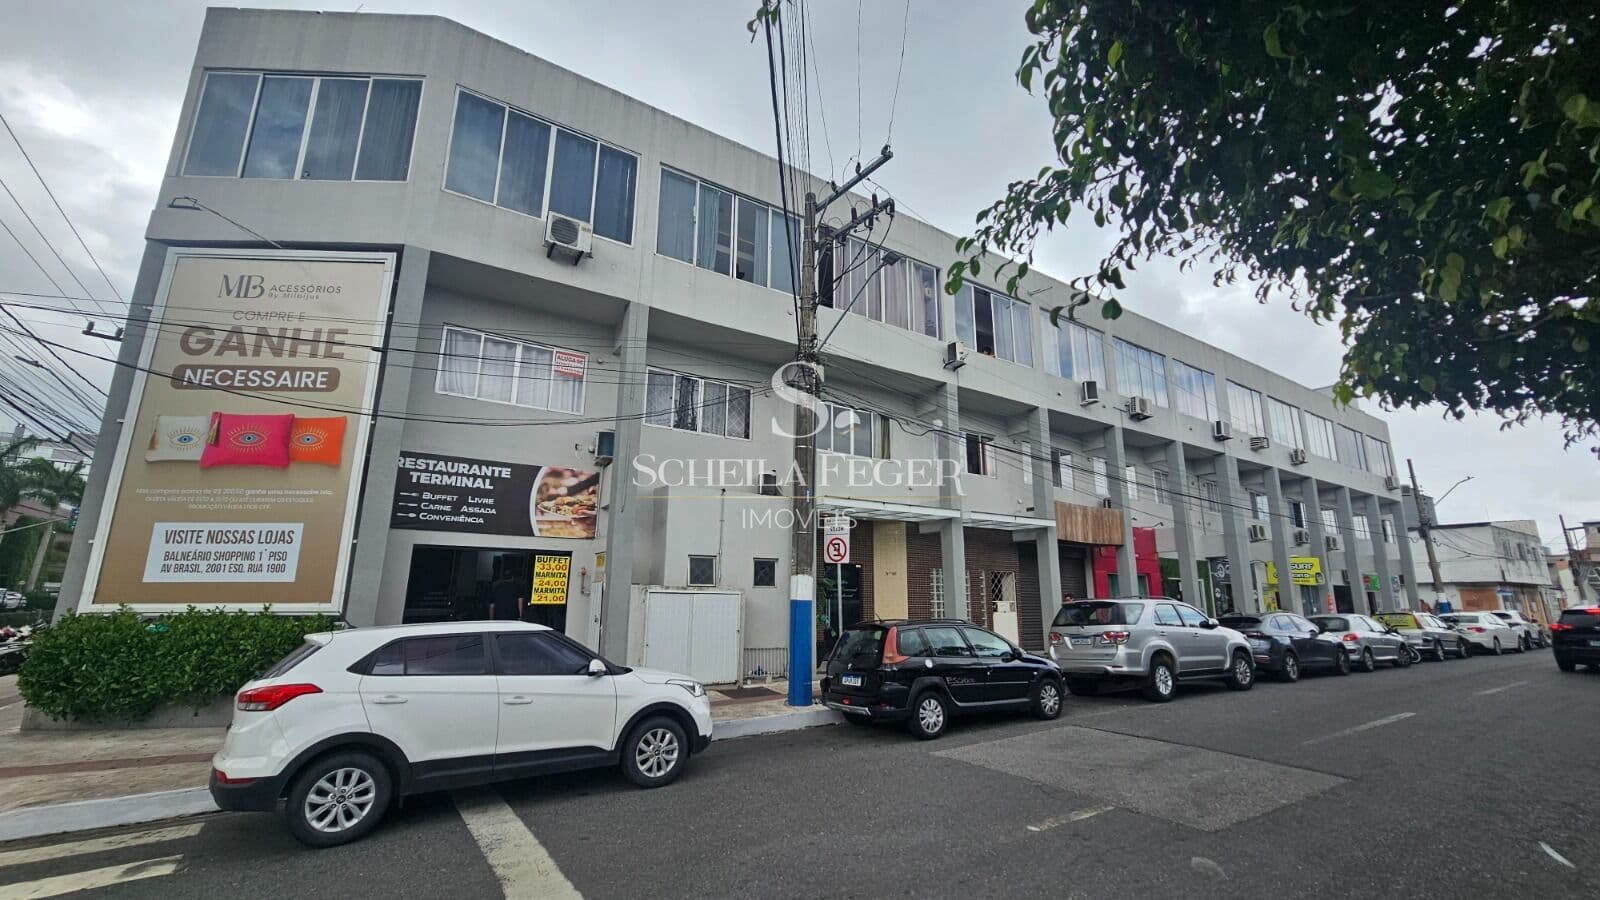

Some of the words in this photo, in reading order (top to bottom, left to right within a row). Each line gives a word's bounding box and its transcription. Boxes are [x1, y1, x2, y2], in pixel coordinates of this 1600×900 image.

[269, 283, 342, 294] ACESSÓRIOS
[232, 310, 295, 322] COMPRE
[299, 311, 306, 322] E
[180, 325, 348, 358] GANHE
[183, 368, 329, 388] NECESSAIRE
[397, 457, 512, 479] RESTAURANTE
[409, 471, 494, 490] TERMINAL
[164, 529, 204, 544] VISITE
[205, 529, 256, 544] NOSSAS
[257, 529, 295, 545] LOJAS
[163, 549, 212, 562] BALNEÁRIO
[213, 550, 256, 562] SHOPPING
[268, 551, 288, 562] PISO
[536, 556, 569, 564] BUFFET
[160, 563, 172, 573] AV
[247, 563, 263, 573] RUA
[266, 563, 287, 573] 1900
[535, 571, 567, 579] MARMITA
[534, 587, 566, 595] MARMITA
